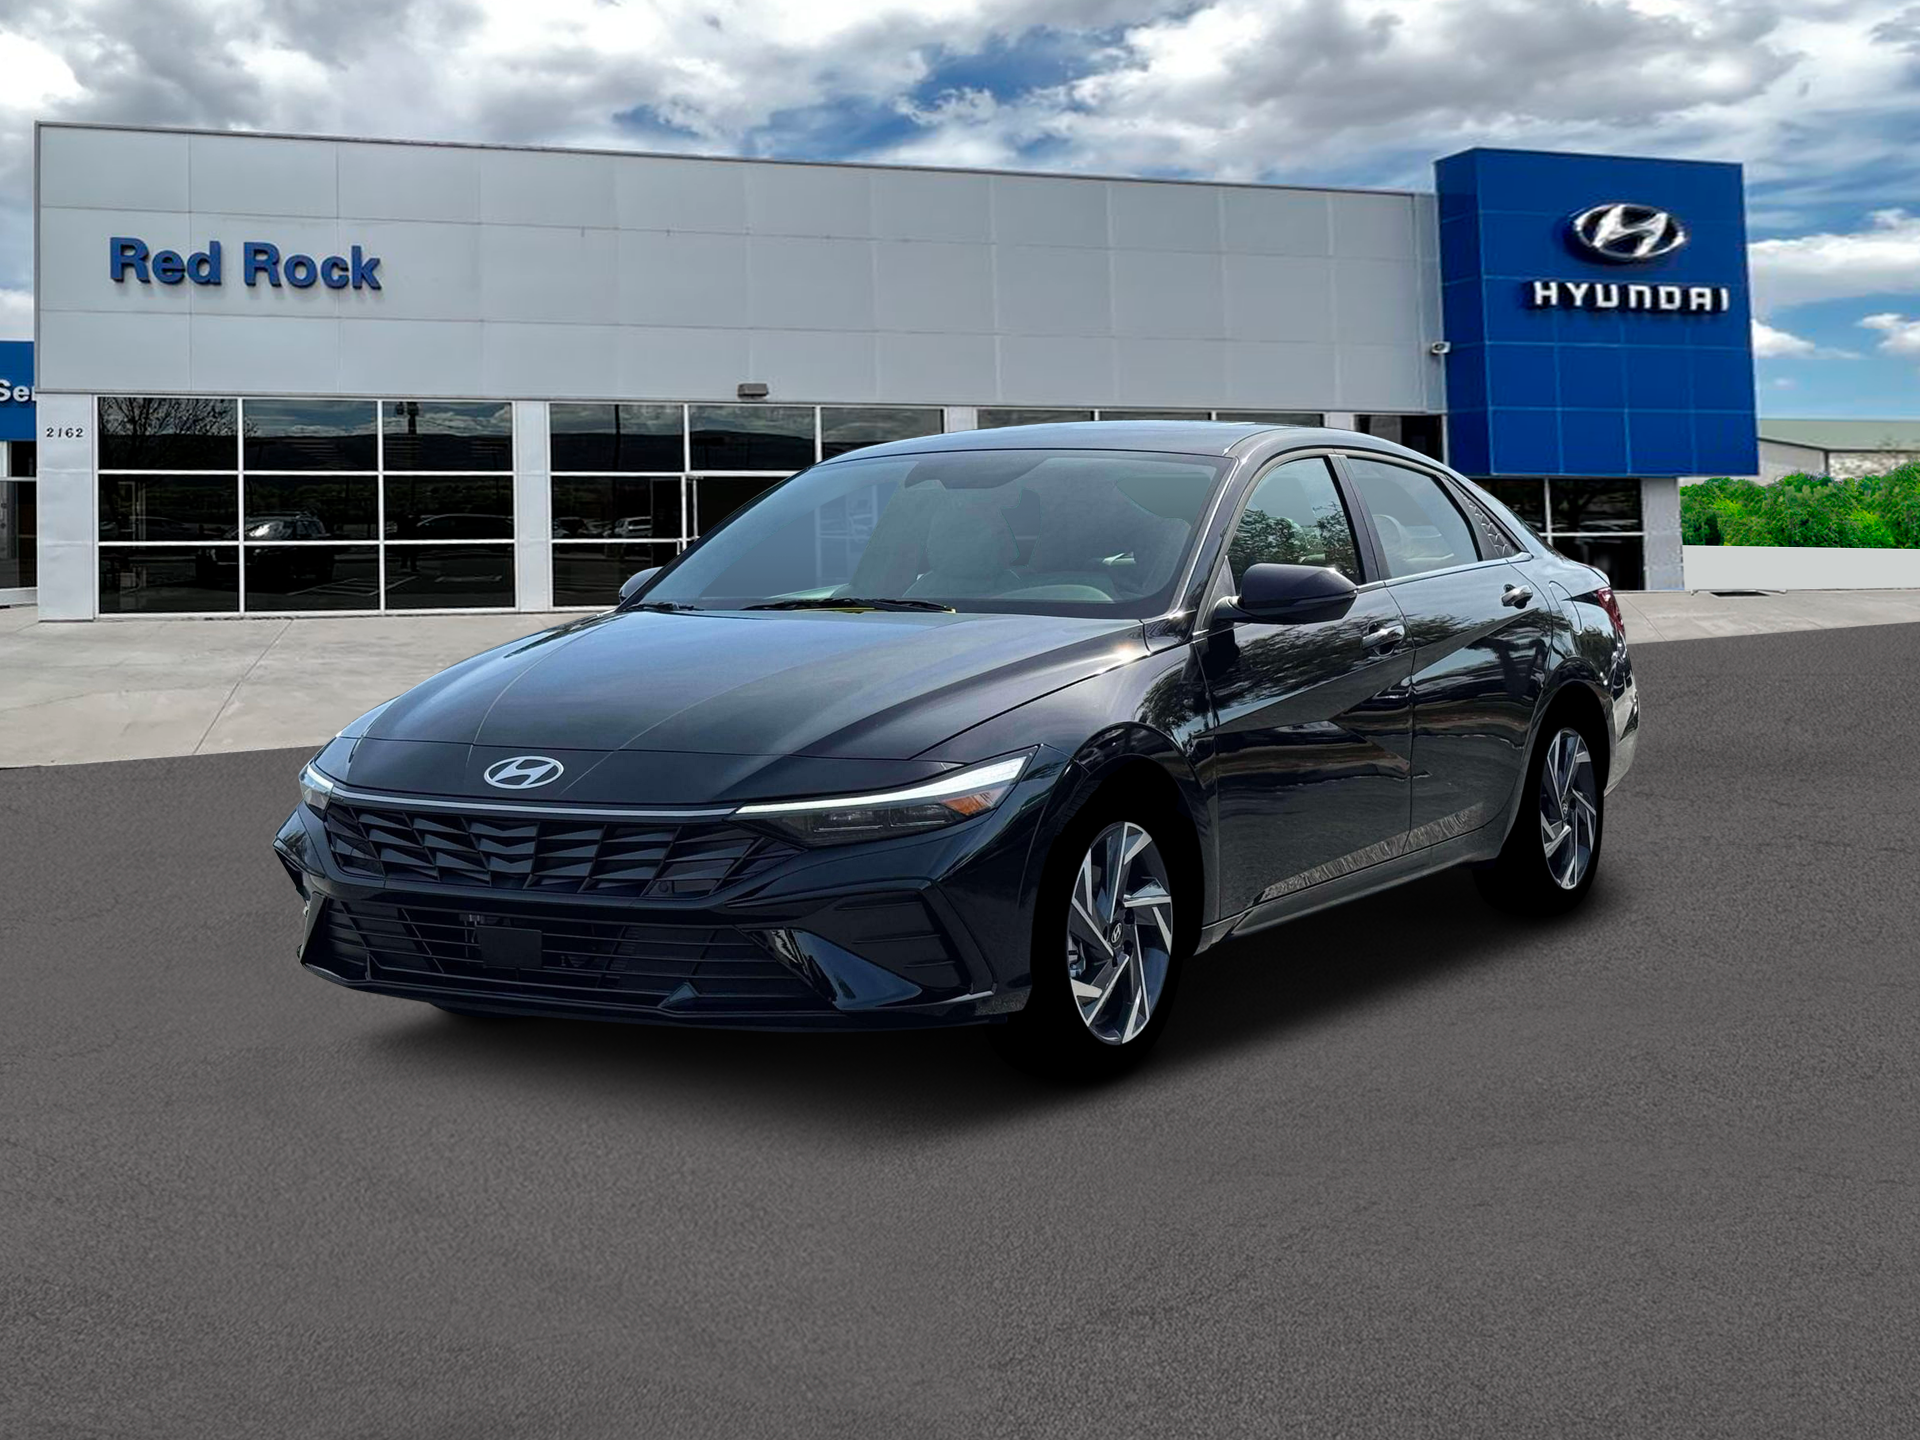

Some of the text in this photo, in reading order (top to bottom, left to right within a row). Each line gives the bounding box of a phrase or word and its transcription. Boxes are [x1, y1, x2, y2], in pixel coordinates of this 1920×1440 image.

[110, 237, 381, 290] Red Rock
[1533, 281, 1729, 312] HYUNDAI
[46, 427, 84, 438] 2162
